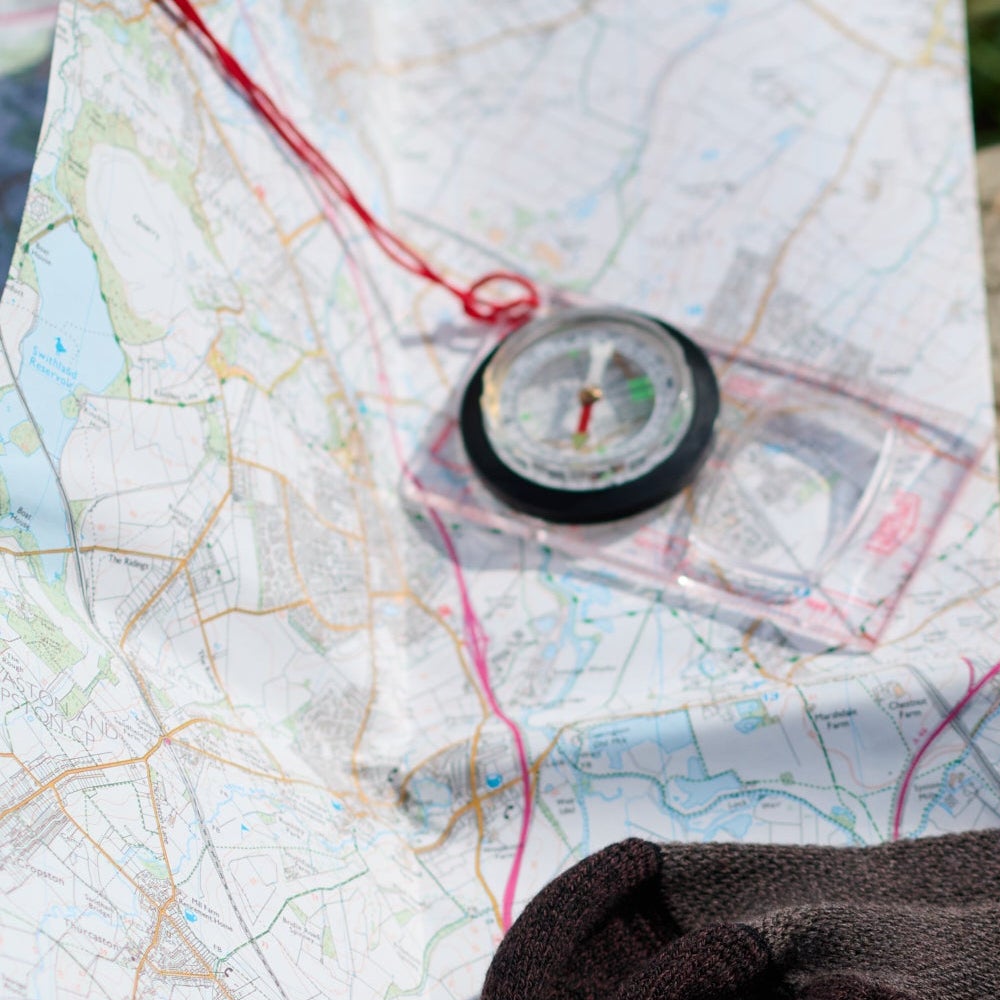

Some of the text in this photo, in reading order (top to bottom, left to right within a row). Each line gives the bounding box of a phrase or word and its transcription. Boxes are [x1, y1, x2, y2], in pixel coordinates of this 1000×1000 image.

[33, 345, 78, 379] Swithland
[17, 858, 65, 886] Cropston
[65, 918, 123, 951] Thurcaston
